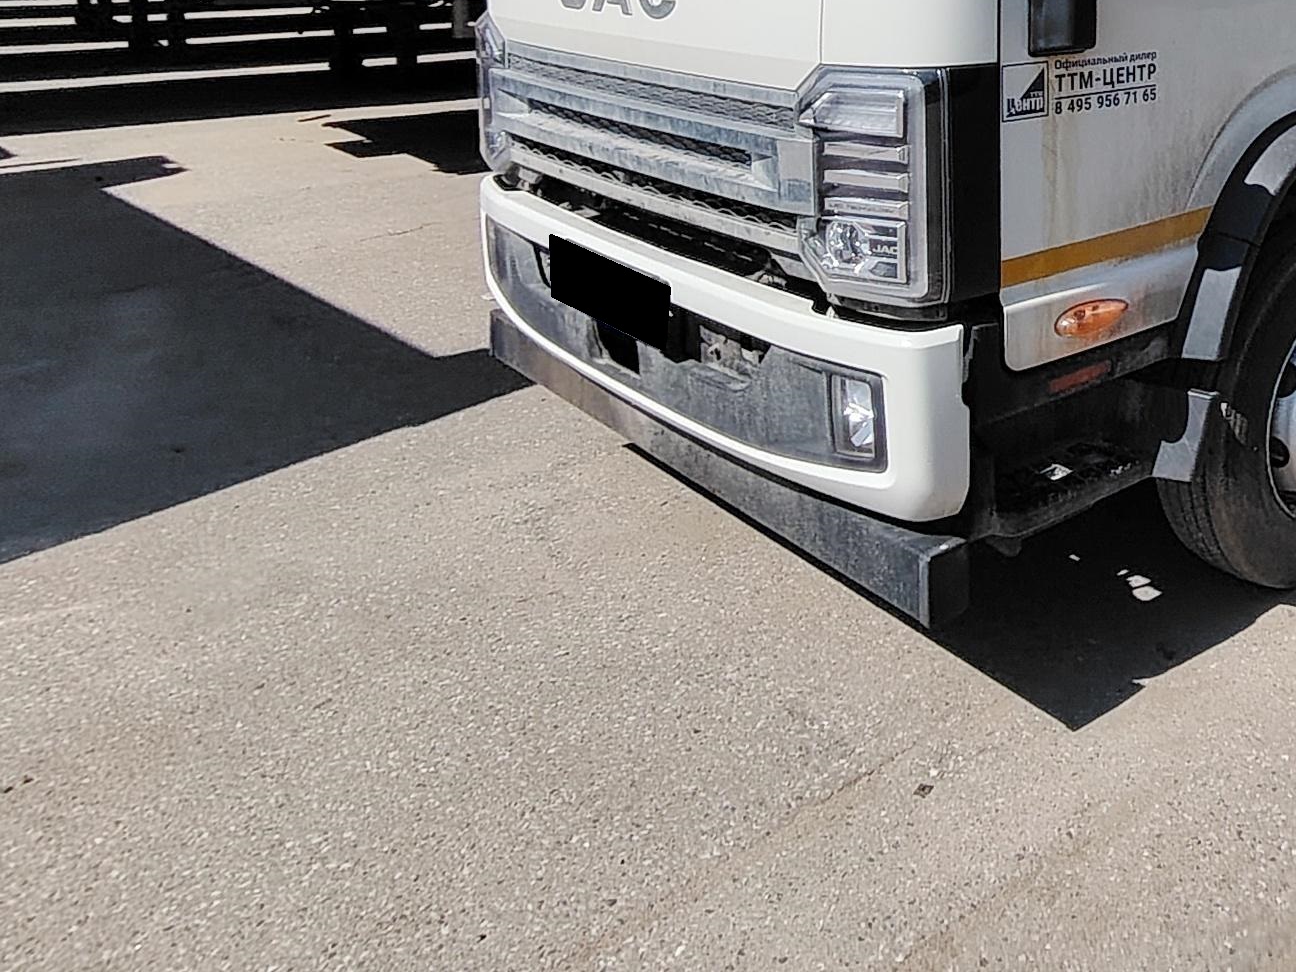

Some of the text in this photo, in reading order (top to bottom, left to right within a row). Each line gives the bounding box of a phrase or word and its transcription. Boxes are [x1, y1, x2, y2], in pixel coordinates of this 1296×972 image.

[1054, 52, 1157, 71] Официальный дилер
[1054, 63, 1157, 92] ТТМ-ЦЕНТР
[1054, 88, 1157, 115] 8 495 956 71 65
